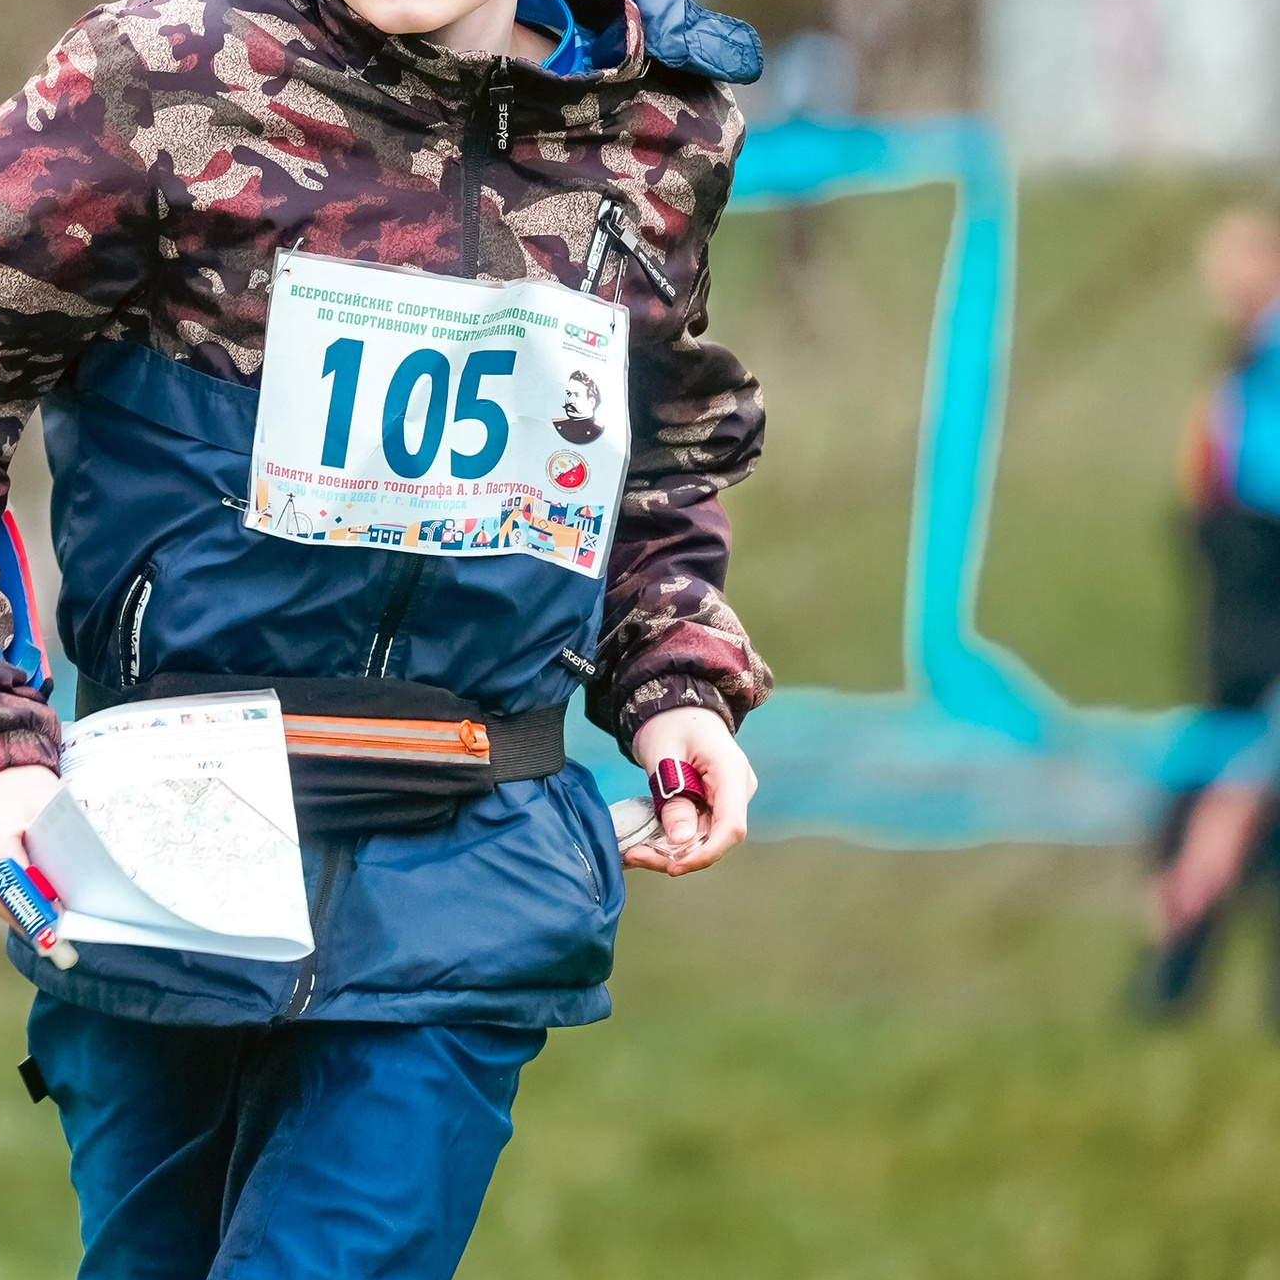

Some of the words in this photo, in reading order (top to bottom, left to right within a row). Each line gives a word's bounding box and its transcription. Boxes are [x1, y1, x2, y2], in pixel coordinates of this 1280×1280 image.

[290, 284, 393, 312] ВСЕРОССИЙСКИЕ
[397, 302, 480, 325] СПОРТИВНЫЕ
[482, 307, 559, 329] СОРЕВНОВАНИЯ
[317, 307, 333, 321] ПО
[338, 311, 428, 336] СПОРТИВНОМУ
[432, 324, 526, 341] ОРИЕНТИРОВАНИЮ
[320, 337, 517, 479] 105
[266, 462, 313, 483] Памяти
[317, 474, 379, 490] военного
[383, 481, 452, 498] топографа
[457, 483, 468, 495] А.
[472, 484, 482, 495] В.
[486, 482, 543, 500] Пастухова
[277, 481, 307, 496] 25-30
[311, 489, 346, 502] марта
[350, 491, 376, 502] 2026
[381, 494, 390, 504] г.
[395, 496, 404, 505] г.
[410, 496, 467, 511] Пятигорск
